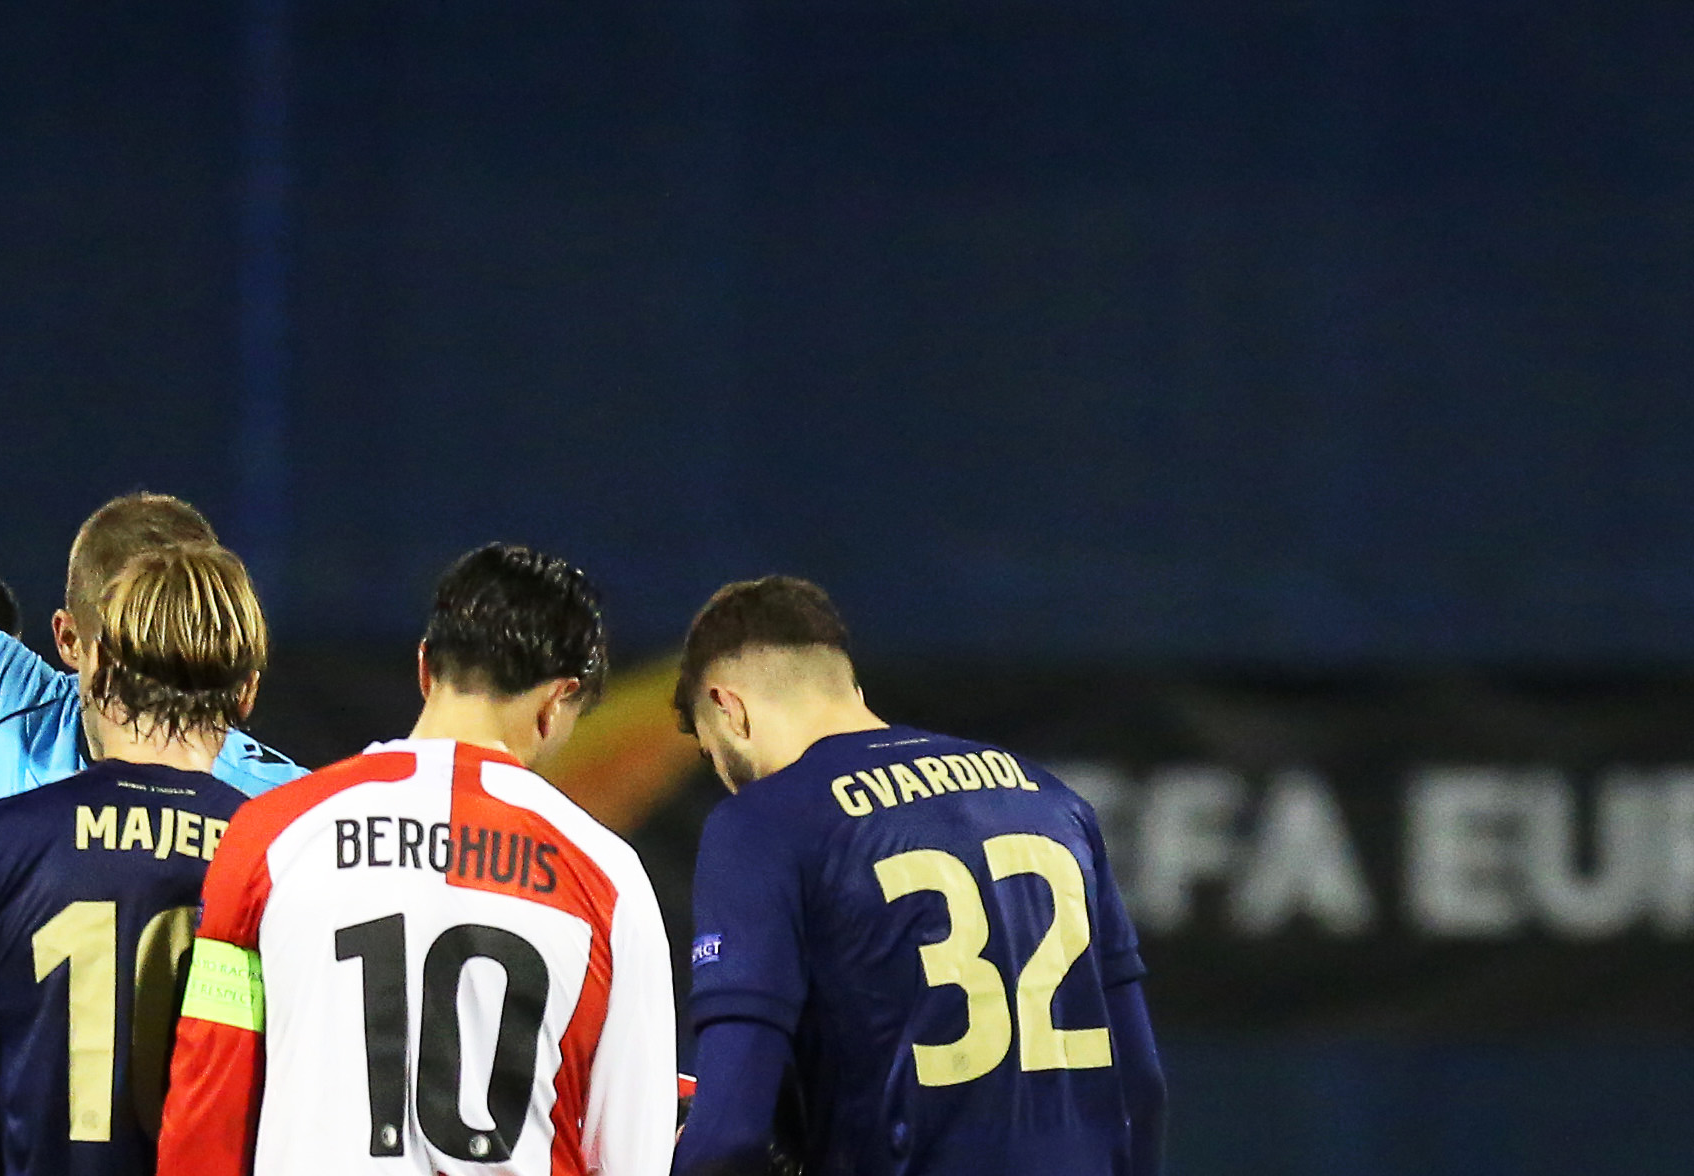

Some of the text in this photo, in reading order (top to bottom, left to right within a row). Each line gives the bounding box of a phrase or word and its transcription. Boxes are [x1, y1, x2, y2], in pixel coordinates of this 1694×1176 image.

[335, 816, 559, 894] BERGHUIS
[831, 749, 1040, 817] GVARDIOL
[334, 913, 551, 1165] 10
[873, 833, 1113, 1087] 32
